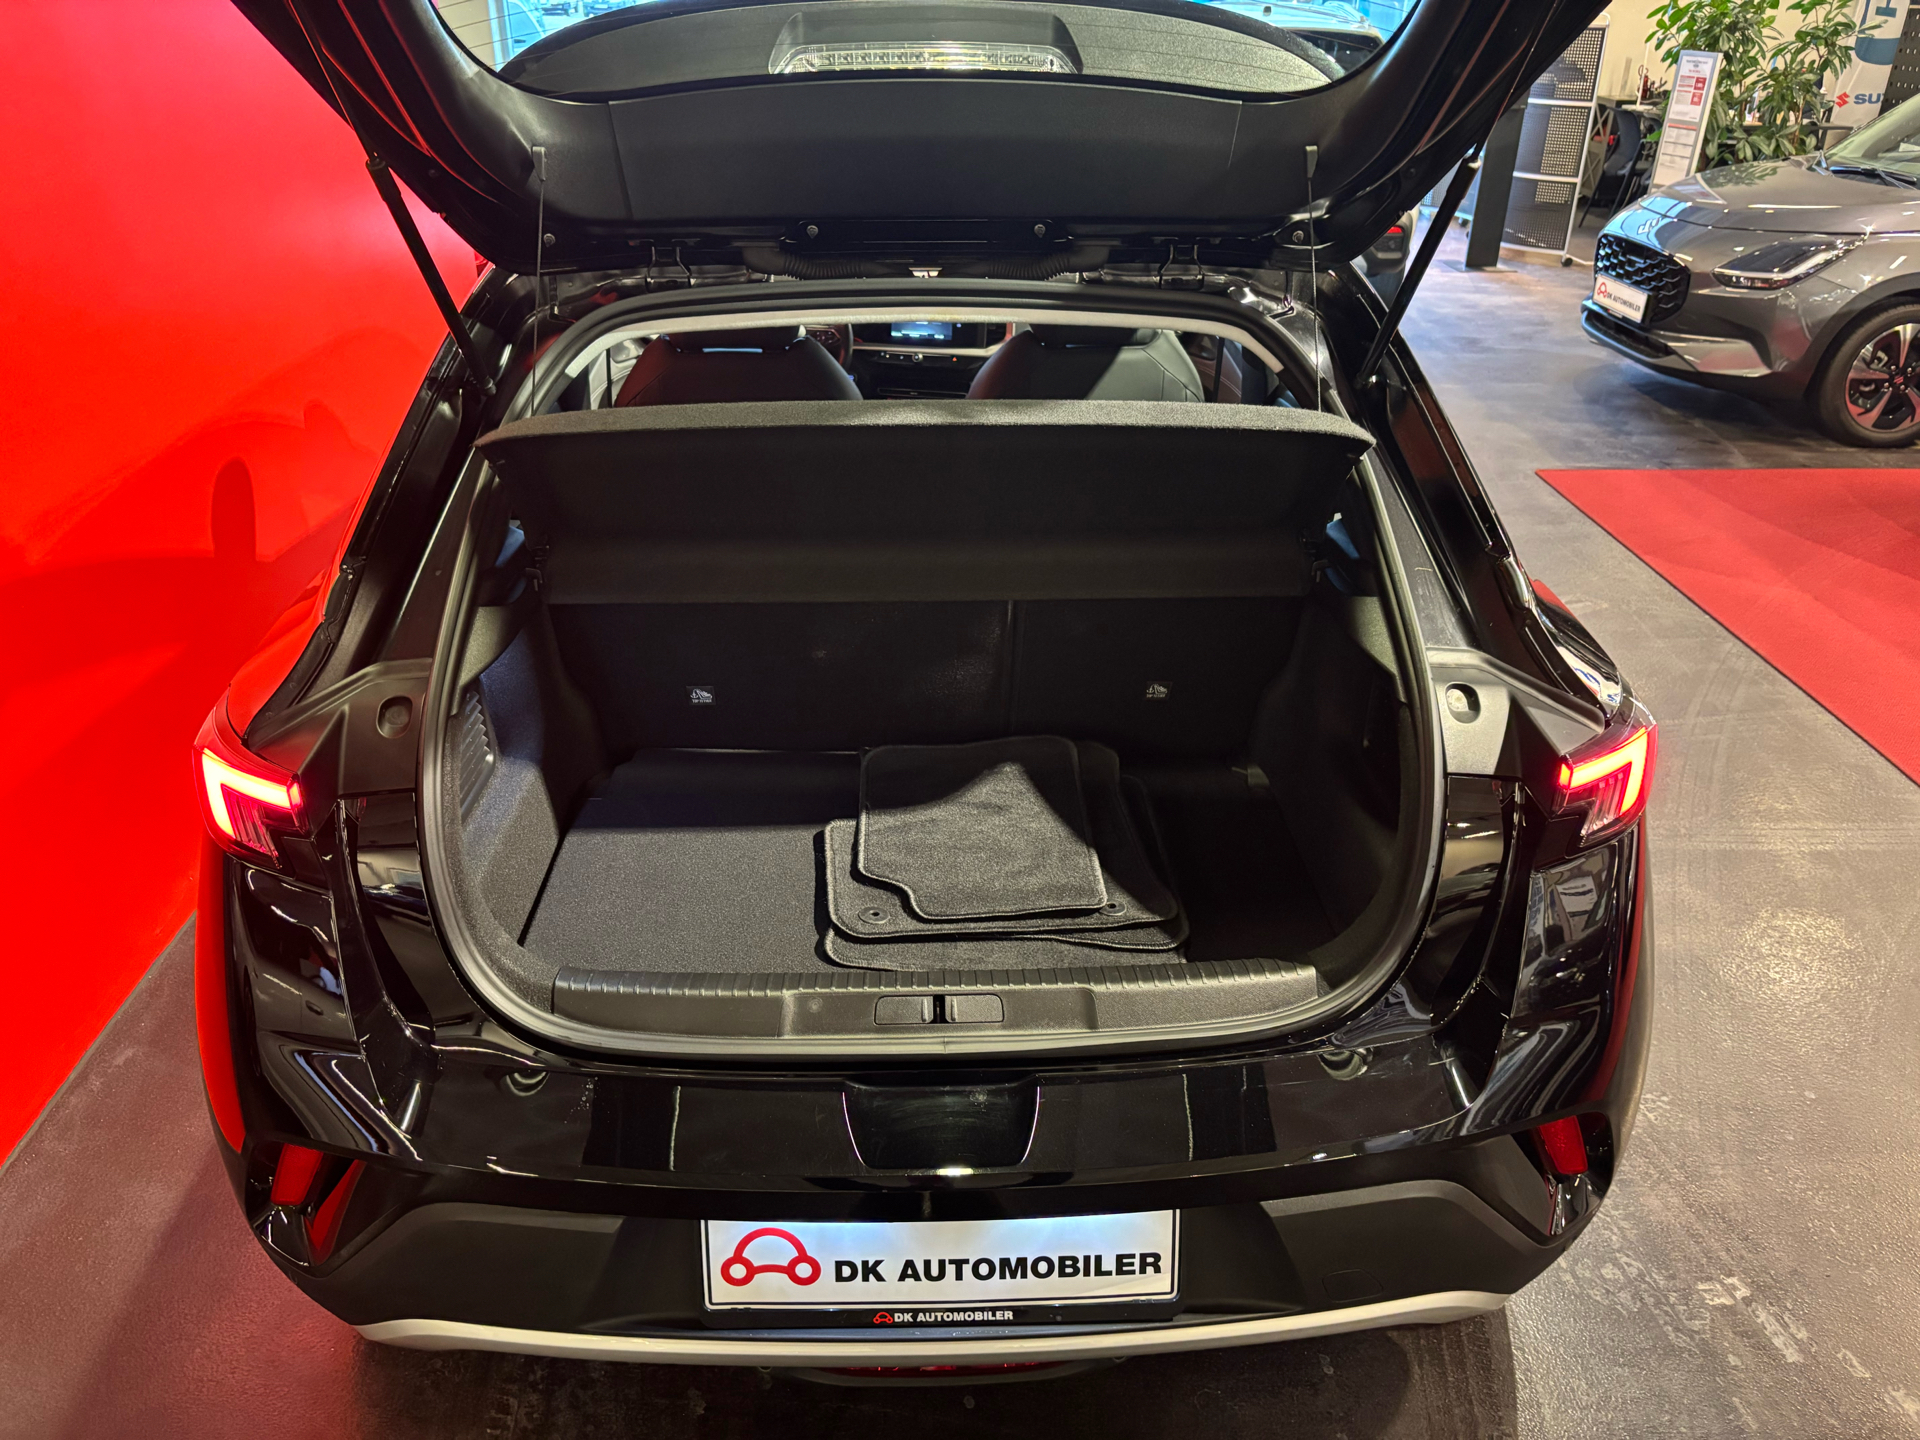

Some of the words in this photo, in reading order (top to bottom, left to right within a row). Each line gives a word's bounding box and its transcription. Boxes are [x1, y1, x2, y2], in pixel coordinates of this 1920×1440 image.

[834, 1259, 886, 1283] DK
[898, 1252, 1162, 1282] AUTOMOBILER
[894, 1312, 914, 1322] DK
[916, 1310, 1014, 1322] AUTOMOBILER
